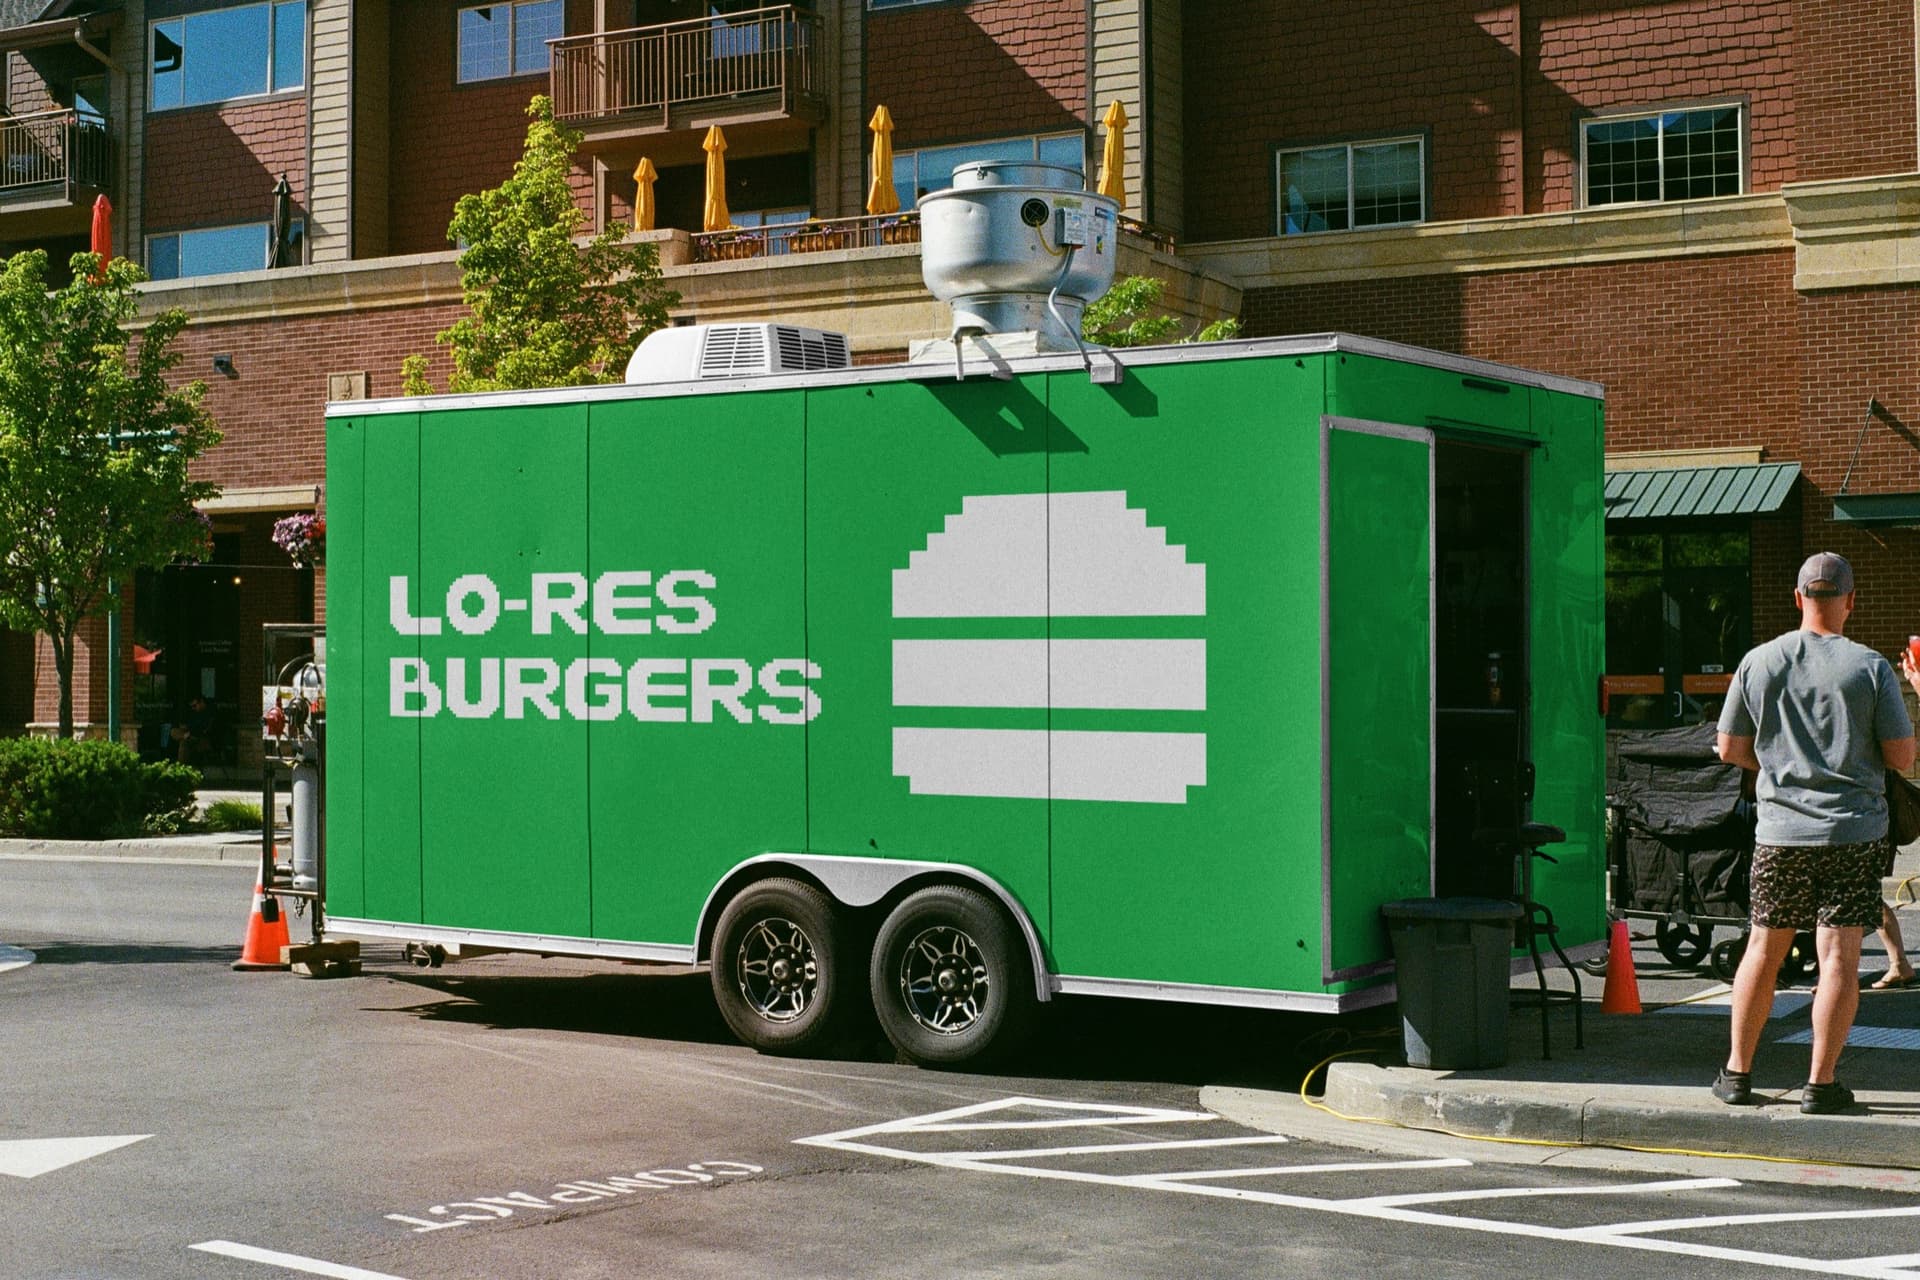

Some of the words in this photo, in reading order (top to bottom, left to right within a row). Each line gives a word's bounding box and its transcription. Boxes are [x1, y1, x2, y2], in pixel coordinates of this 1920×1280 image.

[390, 570, 716, 635] LO-RES
[390, 658, 822, 724] BURGERS
[384, 1161, 763, 1232] COMPACT
